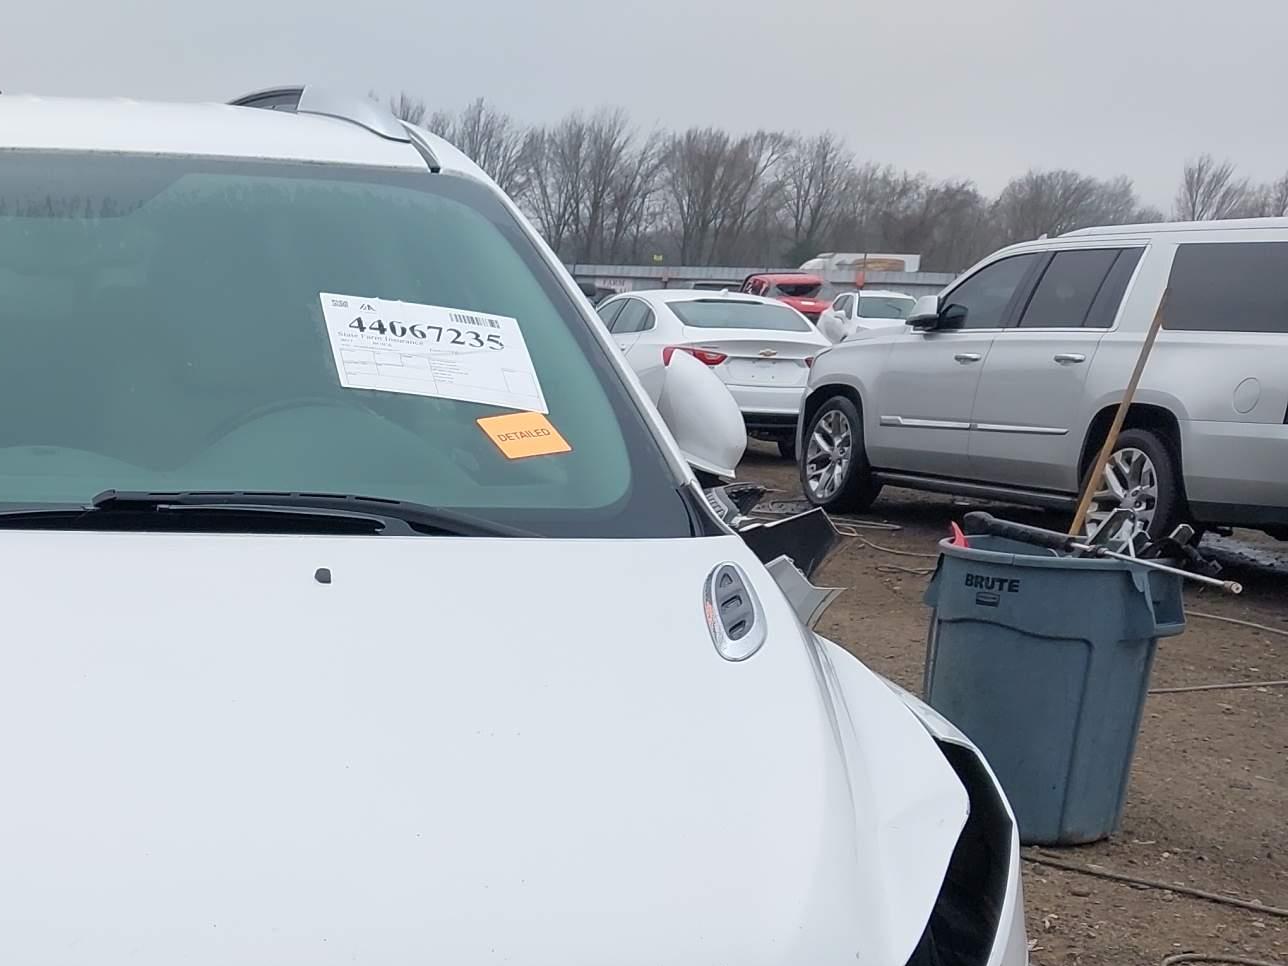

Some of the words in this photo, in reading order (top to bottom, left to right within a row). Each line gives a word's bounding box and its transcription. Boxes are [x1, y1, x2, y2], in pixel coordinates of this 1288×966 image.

[348, 316, 505, 351] 44067235
[497, 429, 551, 442] DETAILED
[965, 573, 1020, 592] BRUTE
